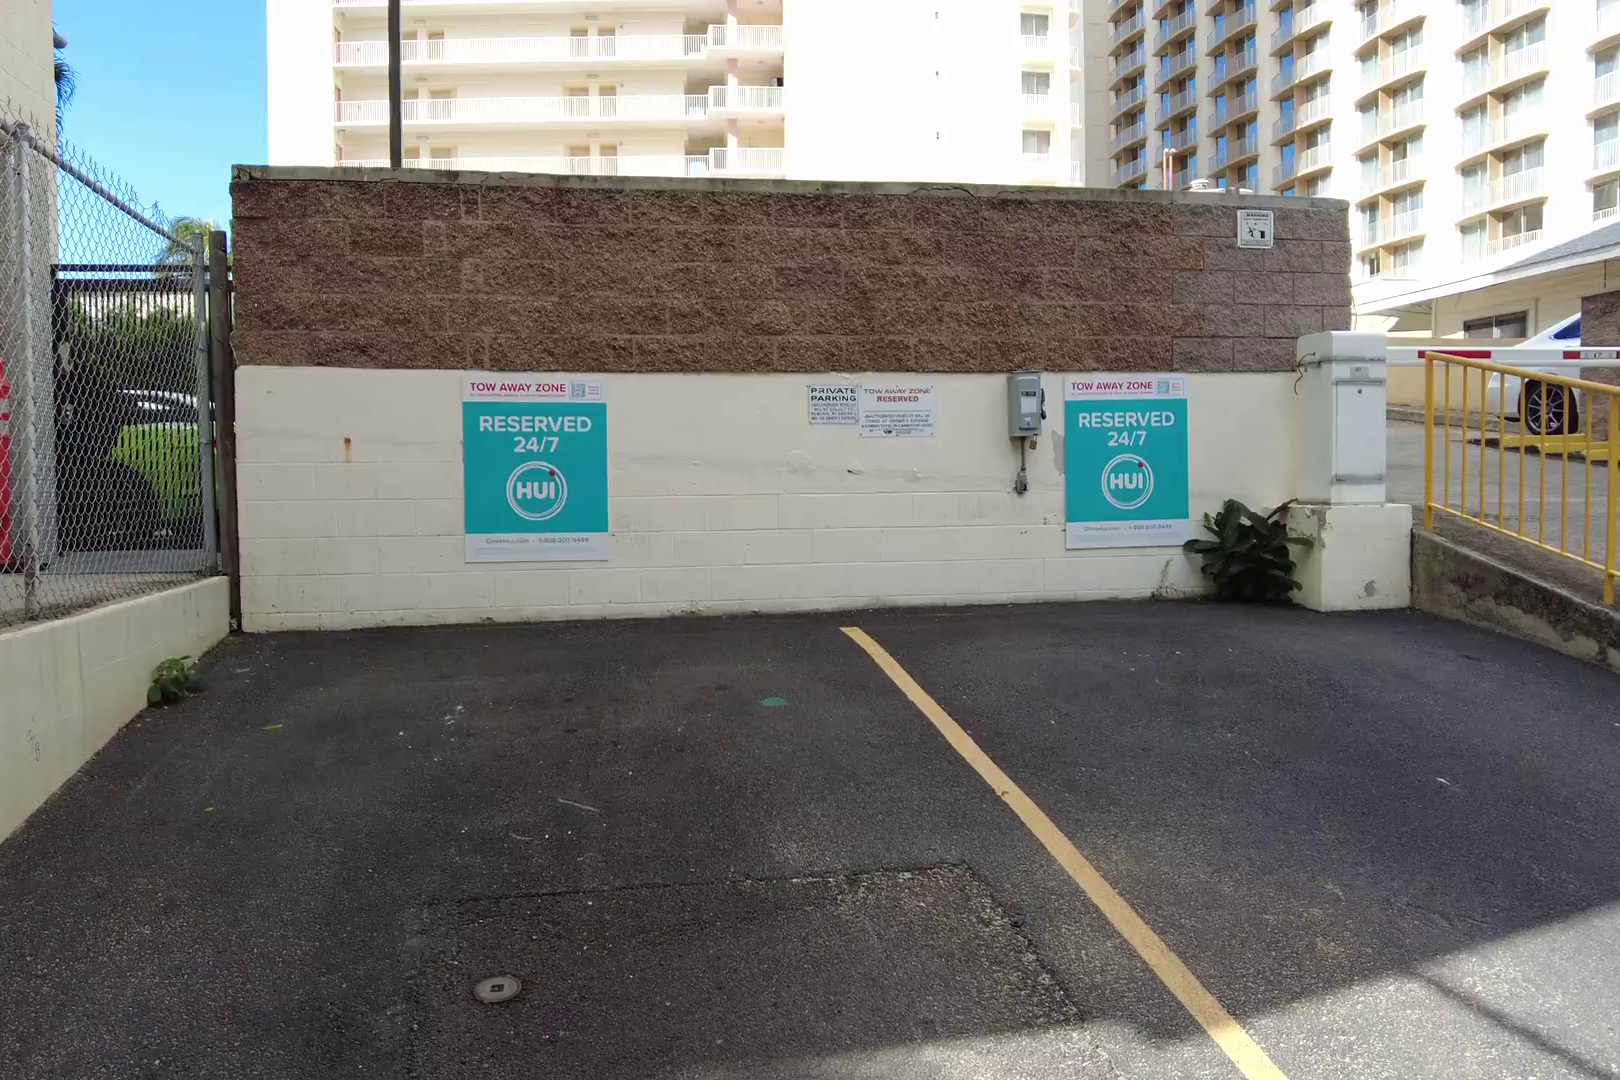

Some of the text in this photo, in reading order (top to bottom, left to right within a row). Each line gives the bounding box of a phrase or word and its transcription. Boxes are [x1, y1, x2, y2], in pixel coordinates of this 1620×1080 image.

[470, 382, 566, 393] TOW AWAY ZONE
[1071, 381, 1153, 391] TOW AWAY ZONE
[479, 415, 592, 432] RESERVED
[1078, 411, 1175, 428] RESERVED
[513, 436, 560, 453] 24/7
[1107, 430, 1147, 447] 24/7
[1110, 472, 1144, 490] HUI
[516, 481, 556, 500] HUI
